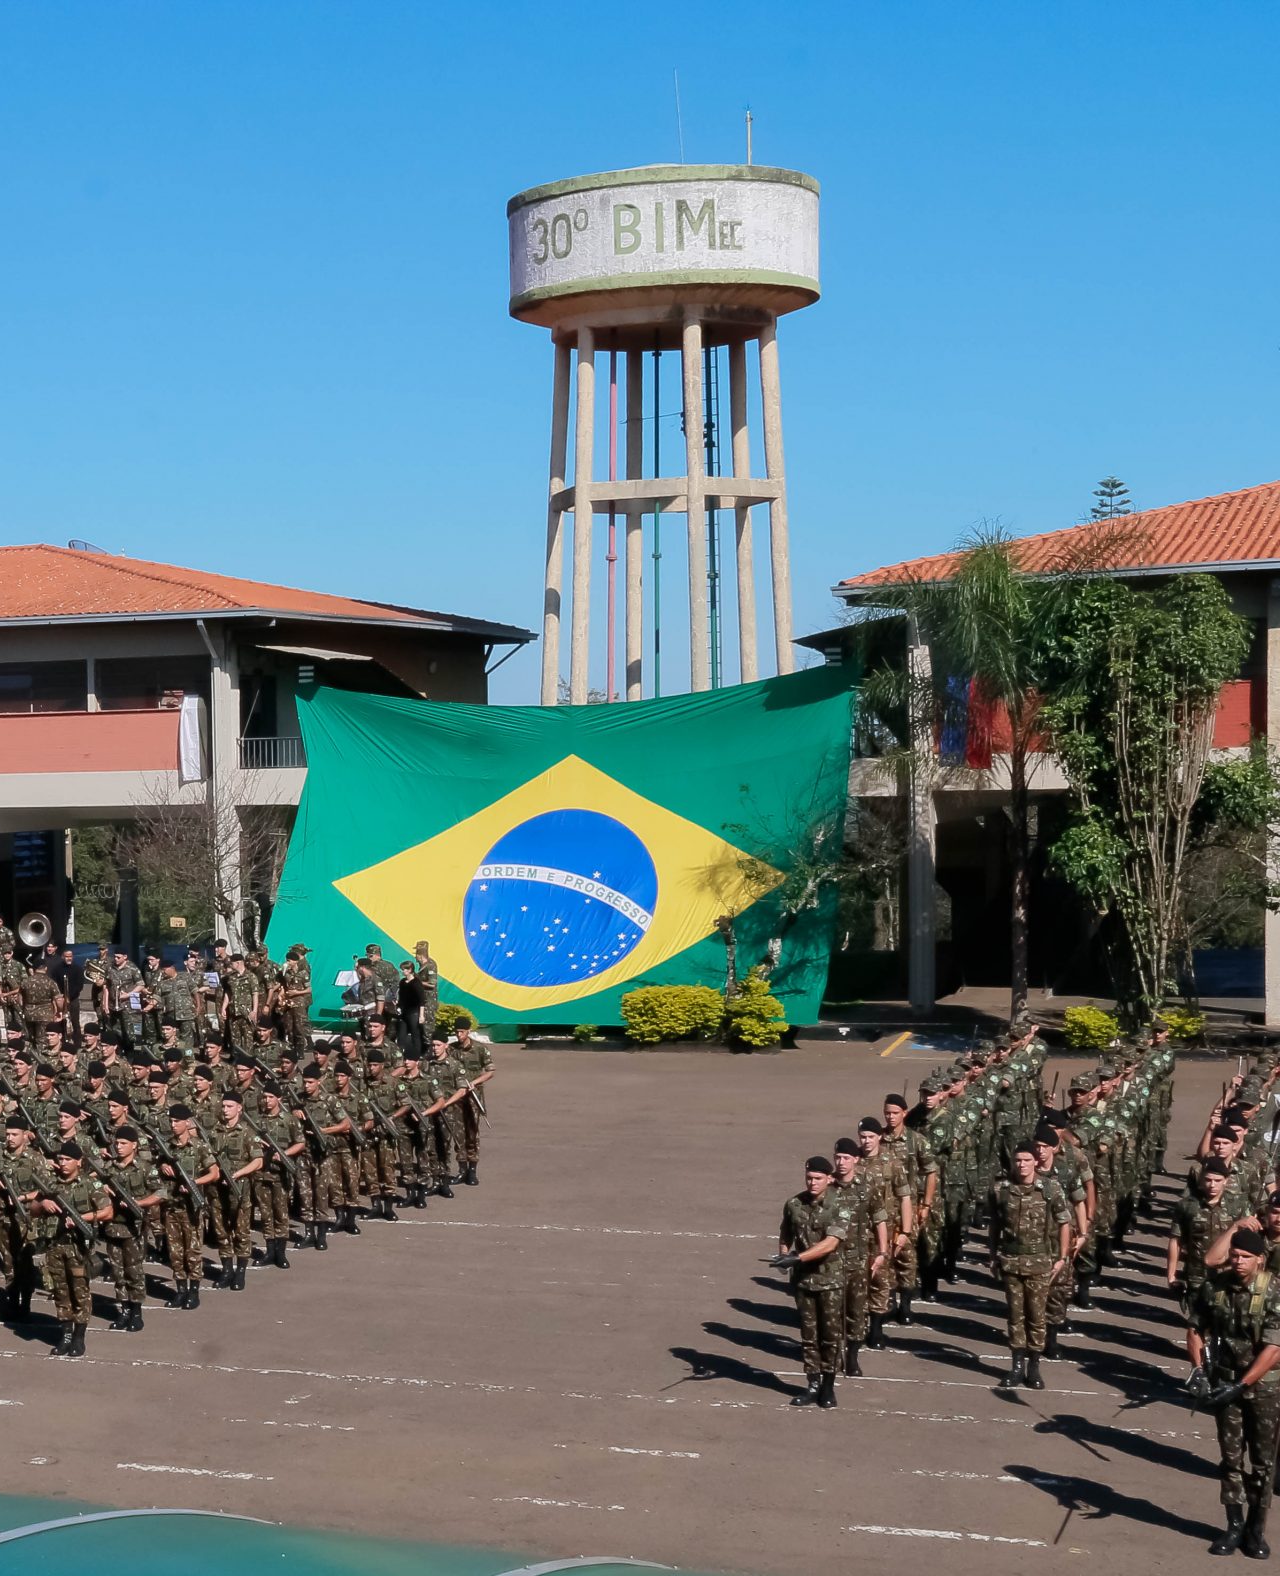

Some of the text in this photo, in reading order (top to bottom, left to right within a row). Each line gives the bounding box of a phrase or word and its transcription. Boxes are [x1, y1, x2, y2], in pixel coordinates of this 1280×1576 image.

[481, 866, 649, 925] ORDEM E PROGRESSO
